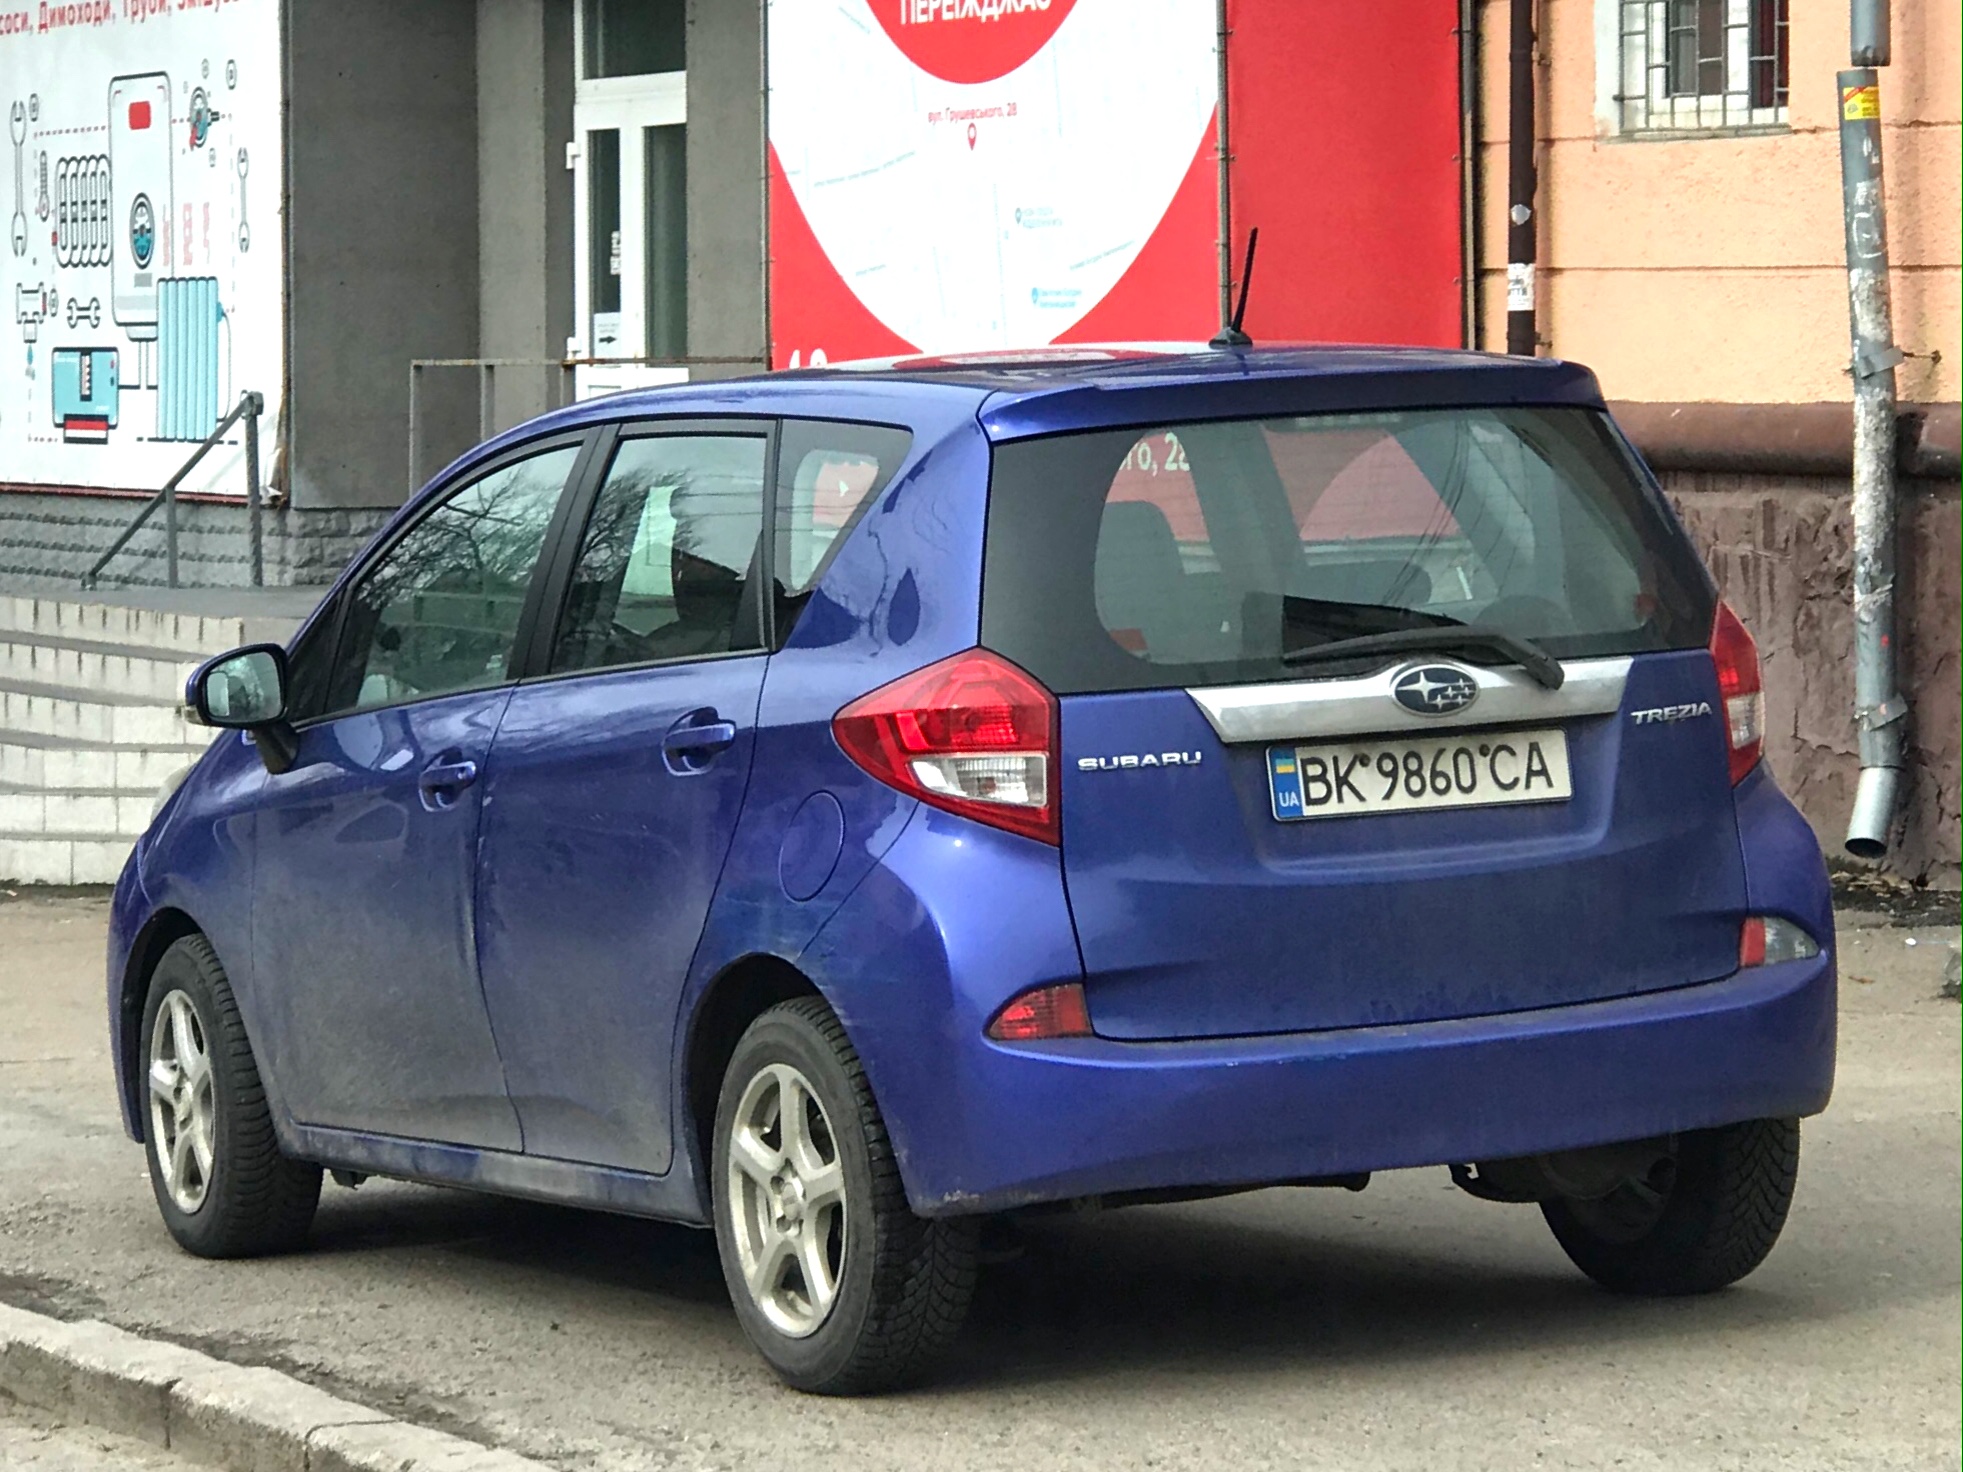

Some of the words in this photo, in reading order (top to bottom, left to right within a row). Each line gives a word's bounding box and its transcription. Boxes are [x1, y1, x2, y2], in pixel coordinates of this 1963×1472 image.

[37, 1, 116, 34] Димоходи,
[1630, 702, 1713, 725] TREZIA
[1078, 751, 1202, 772] SUBARU
[1301, 755, 1367, 806] BK
[1376, 746, 1478, 800] 9860
[1489, 741, 1555, 791] CA
[1278, 791, 1300, 807] UA
